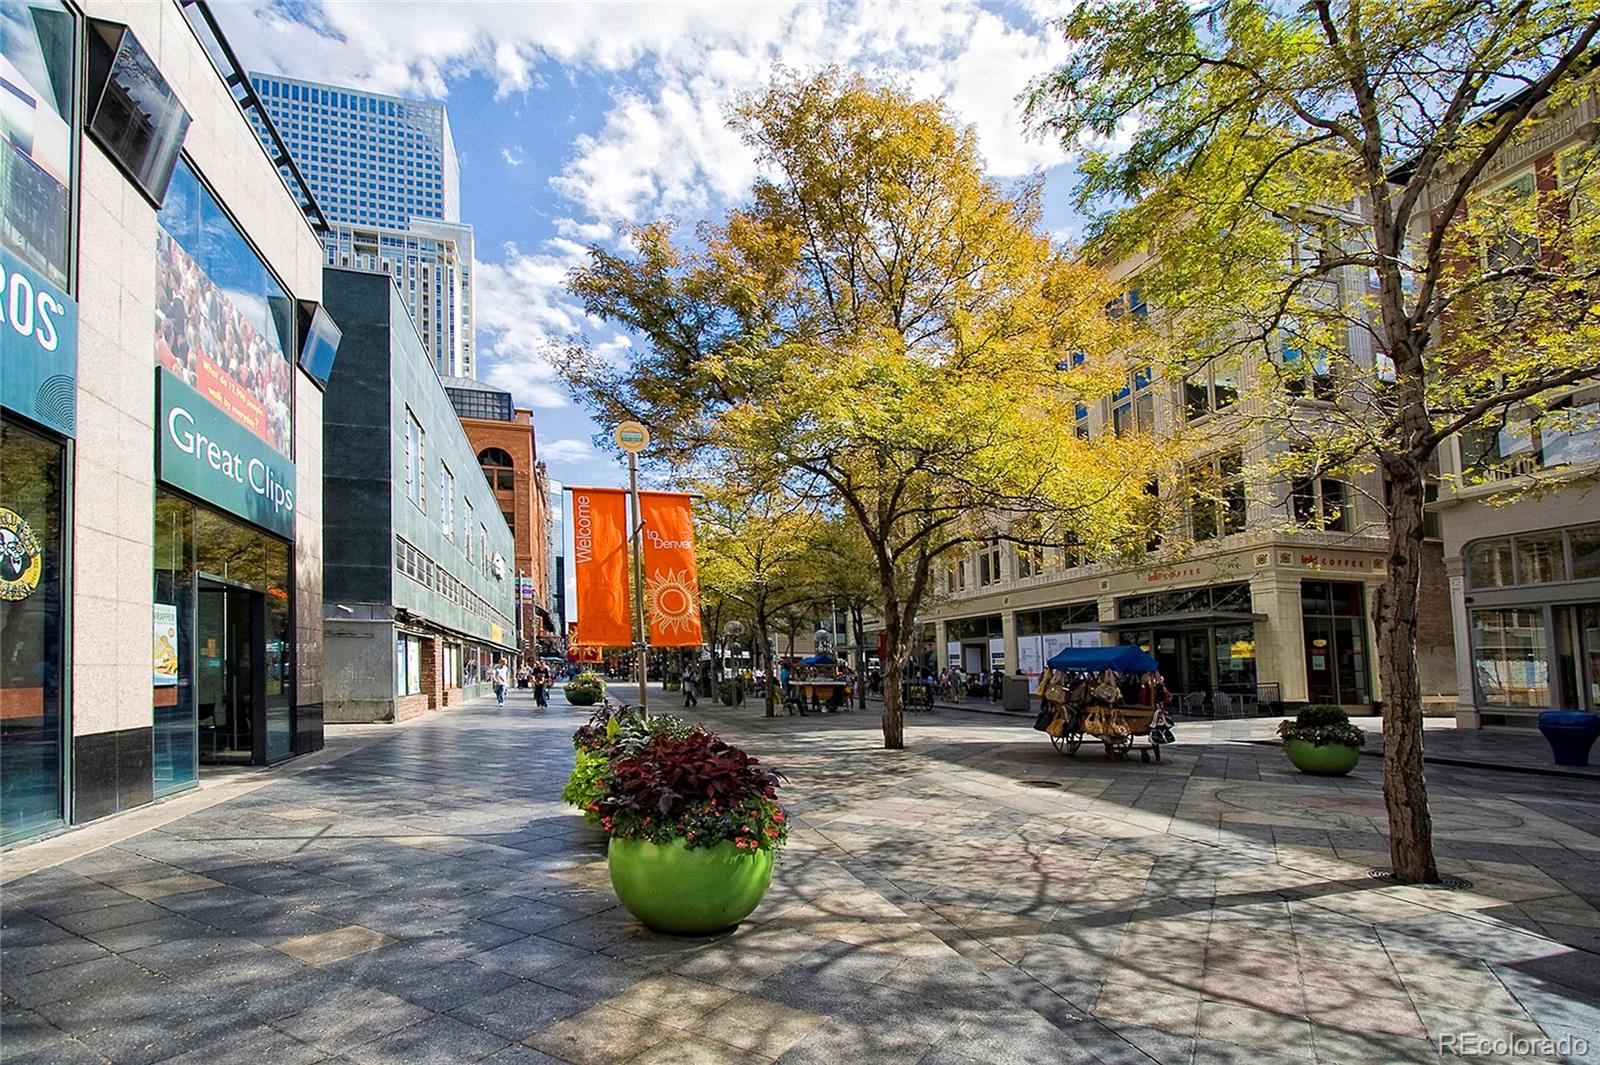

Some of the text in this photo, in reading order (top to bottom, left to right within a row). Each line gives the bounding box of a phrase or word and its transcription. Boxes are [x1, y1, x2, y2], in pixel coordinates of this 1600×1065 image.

[0, 262, 60, 351] OS
[168, 406, 293, 513] Great Clips
[576, 495, 592, 564] Welcome
[646, 529, 659, 540] to
[654, 538, 692, 549] Denver
[1322, 558, 1364, 567] COFFEE
